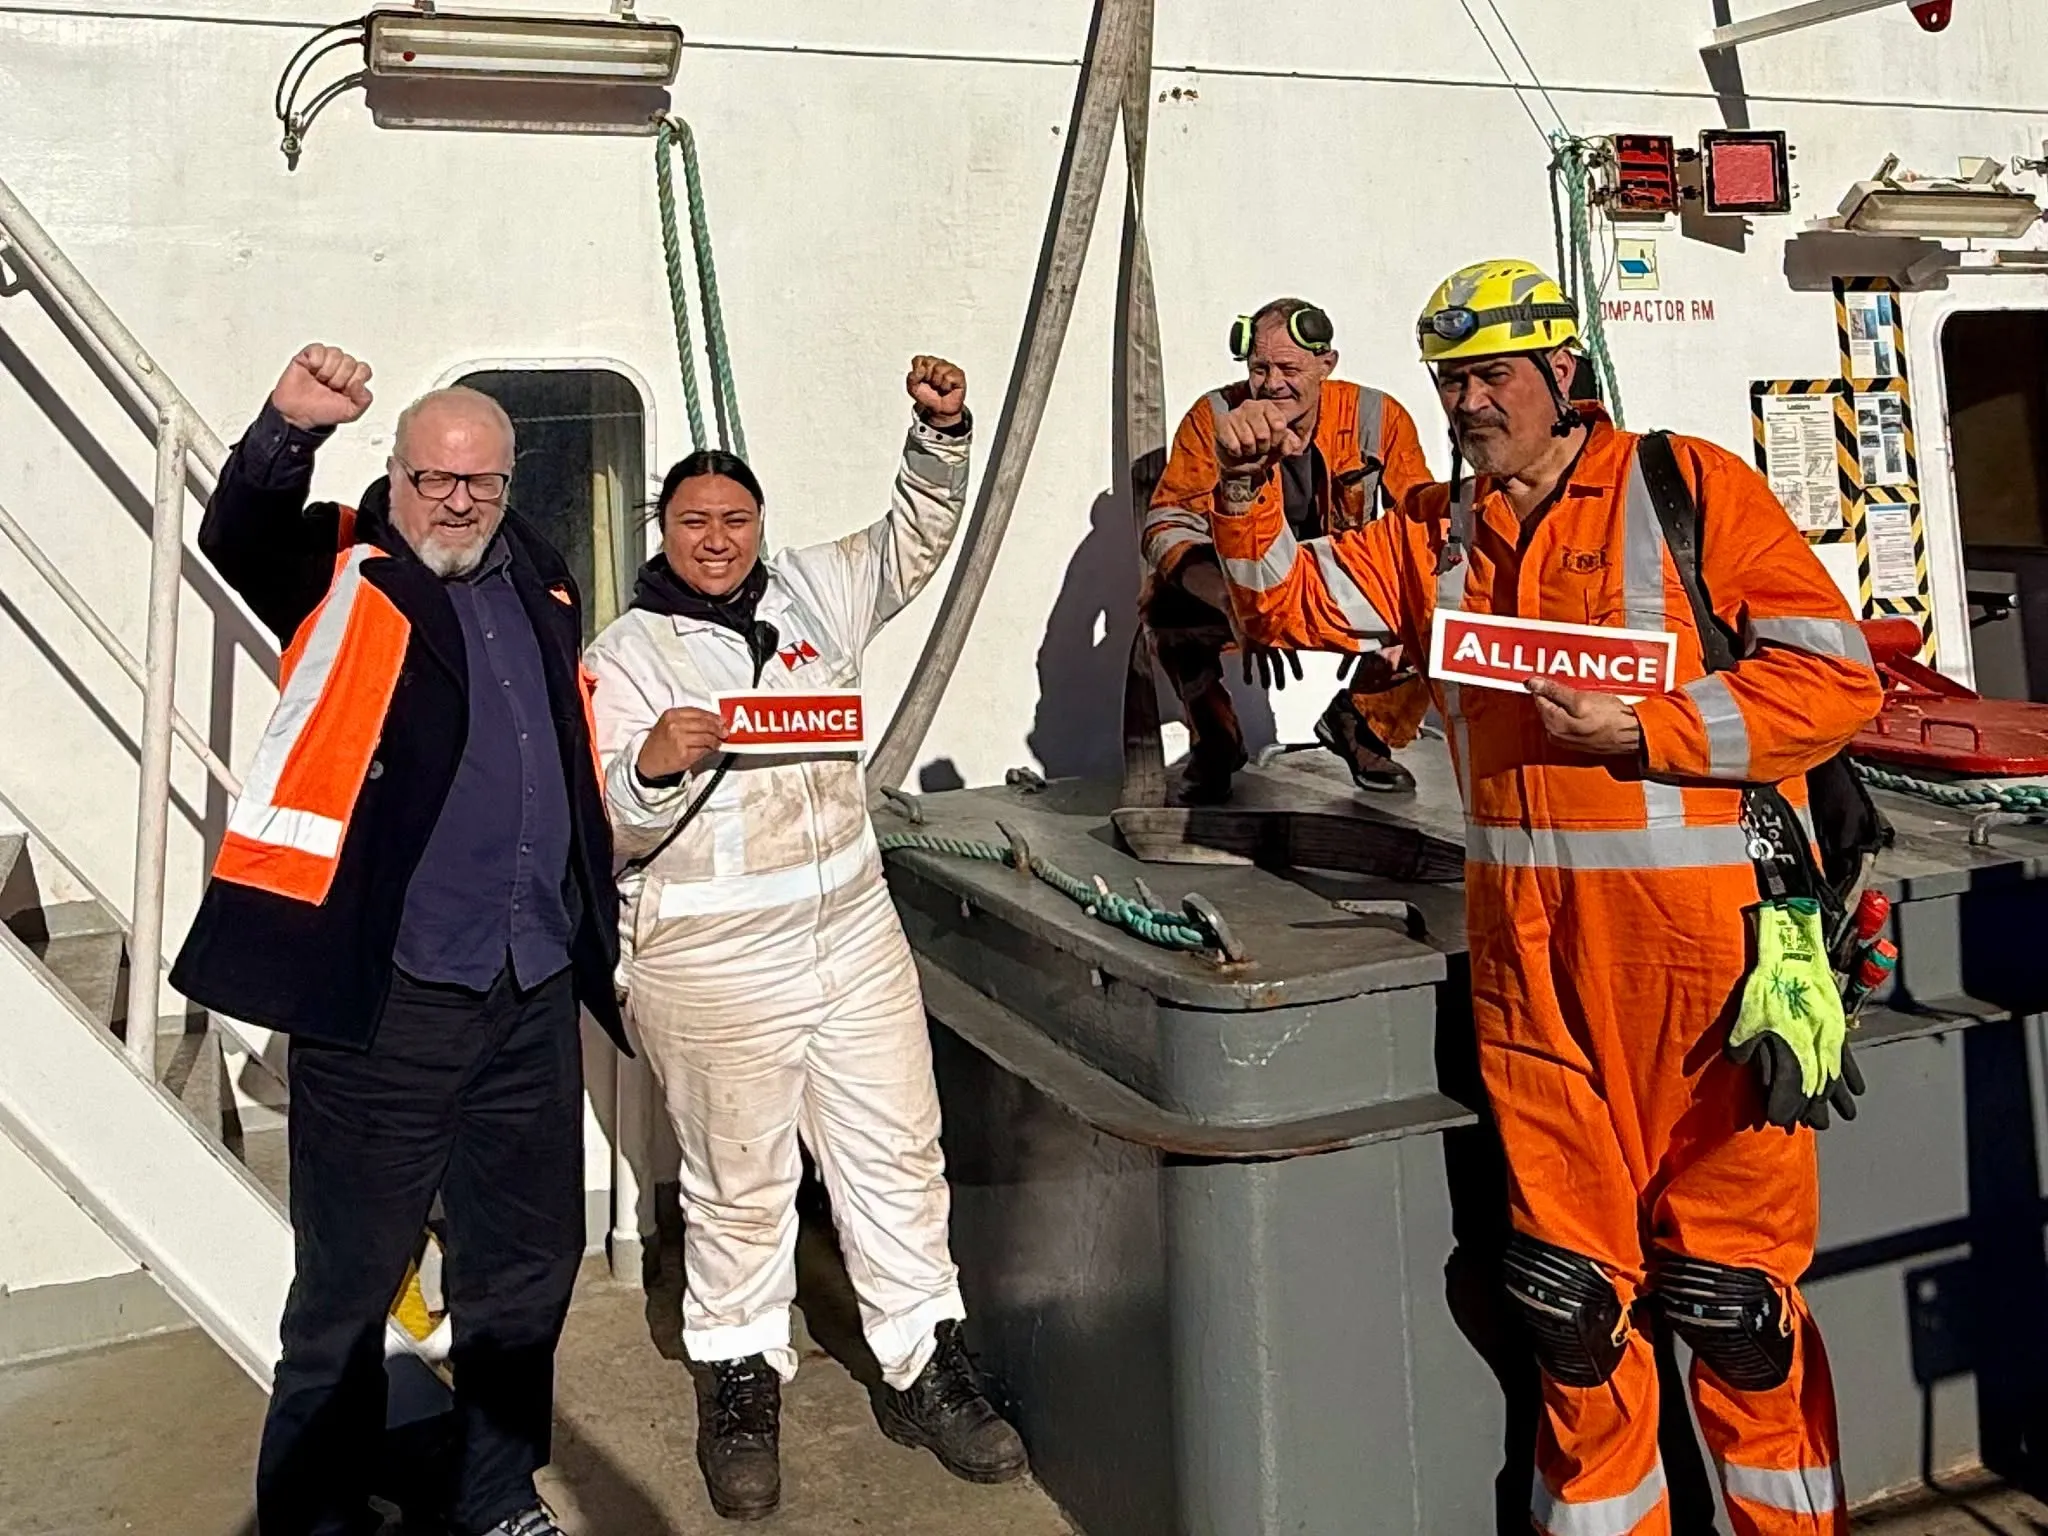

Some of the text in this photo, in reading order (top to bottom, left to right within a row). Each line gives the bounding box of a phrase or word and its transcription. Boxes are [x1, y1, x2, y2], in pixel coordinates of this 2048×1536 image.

[1600, 299, 1715, 322] OMPACTOR RM
[1453, 631, 1659, 684] ALLIANCE
[729, 705, 858, 734] ALLIANCE
